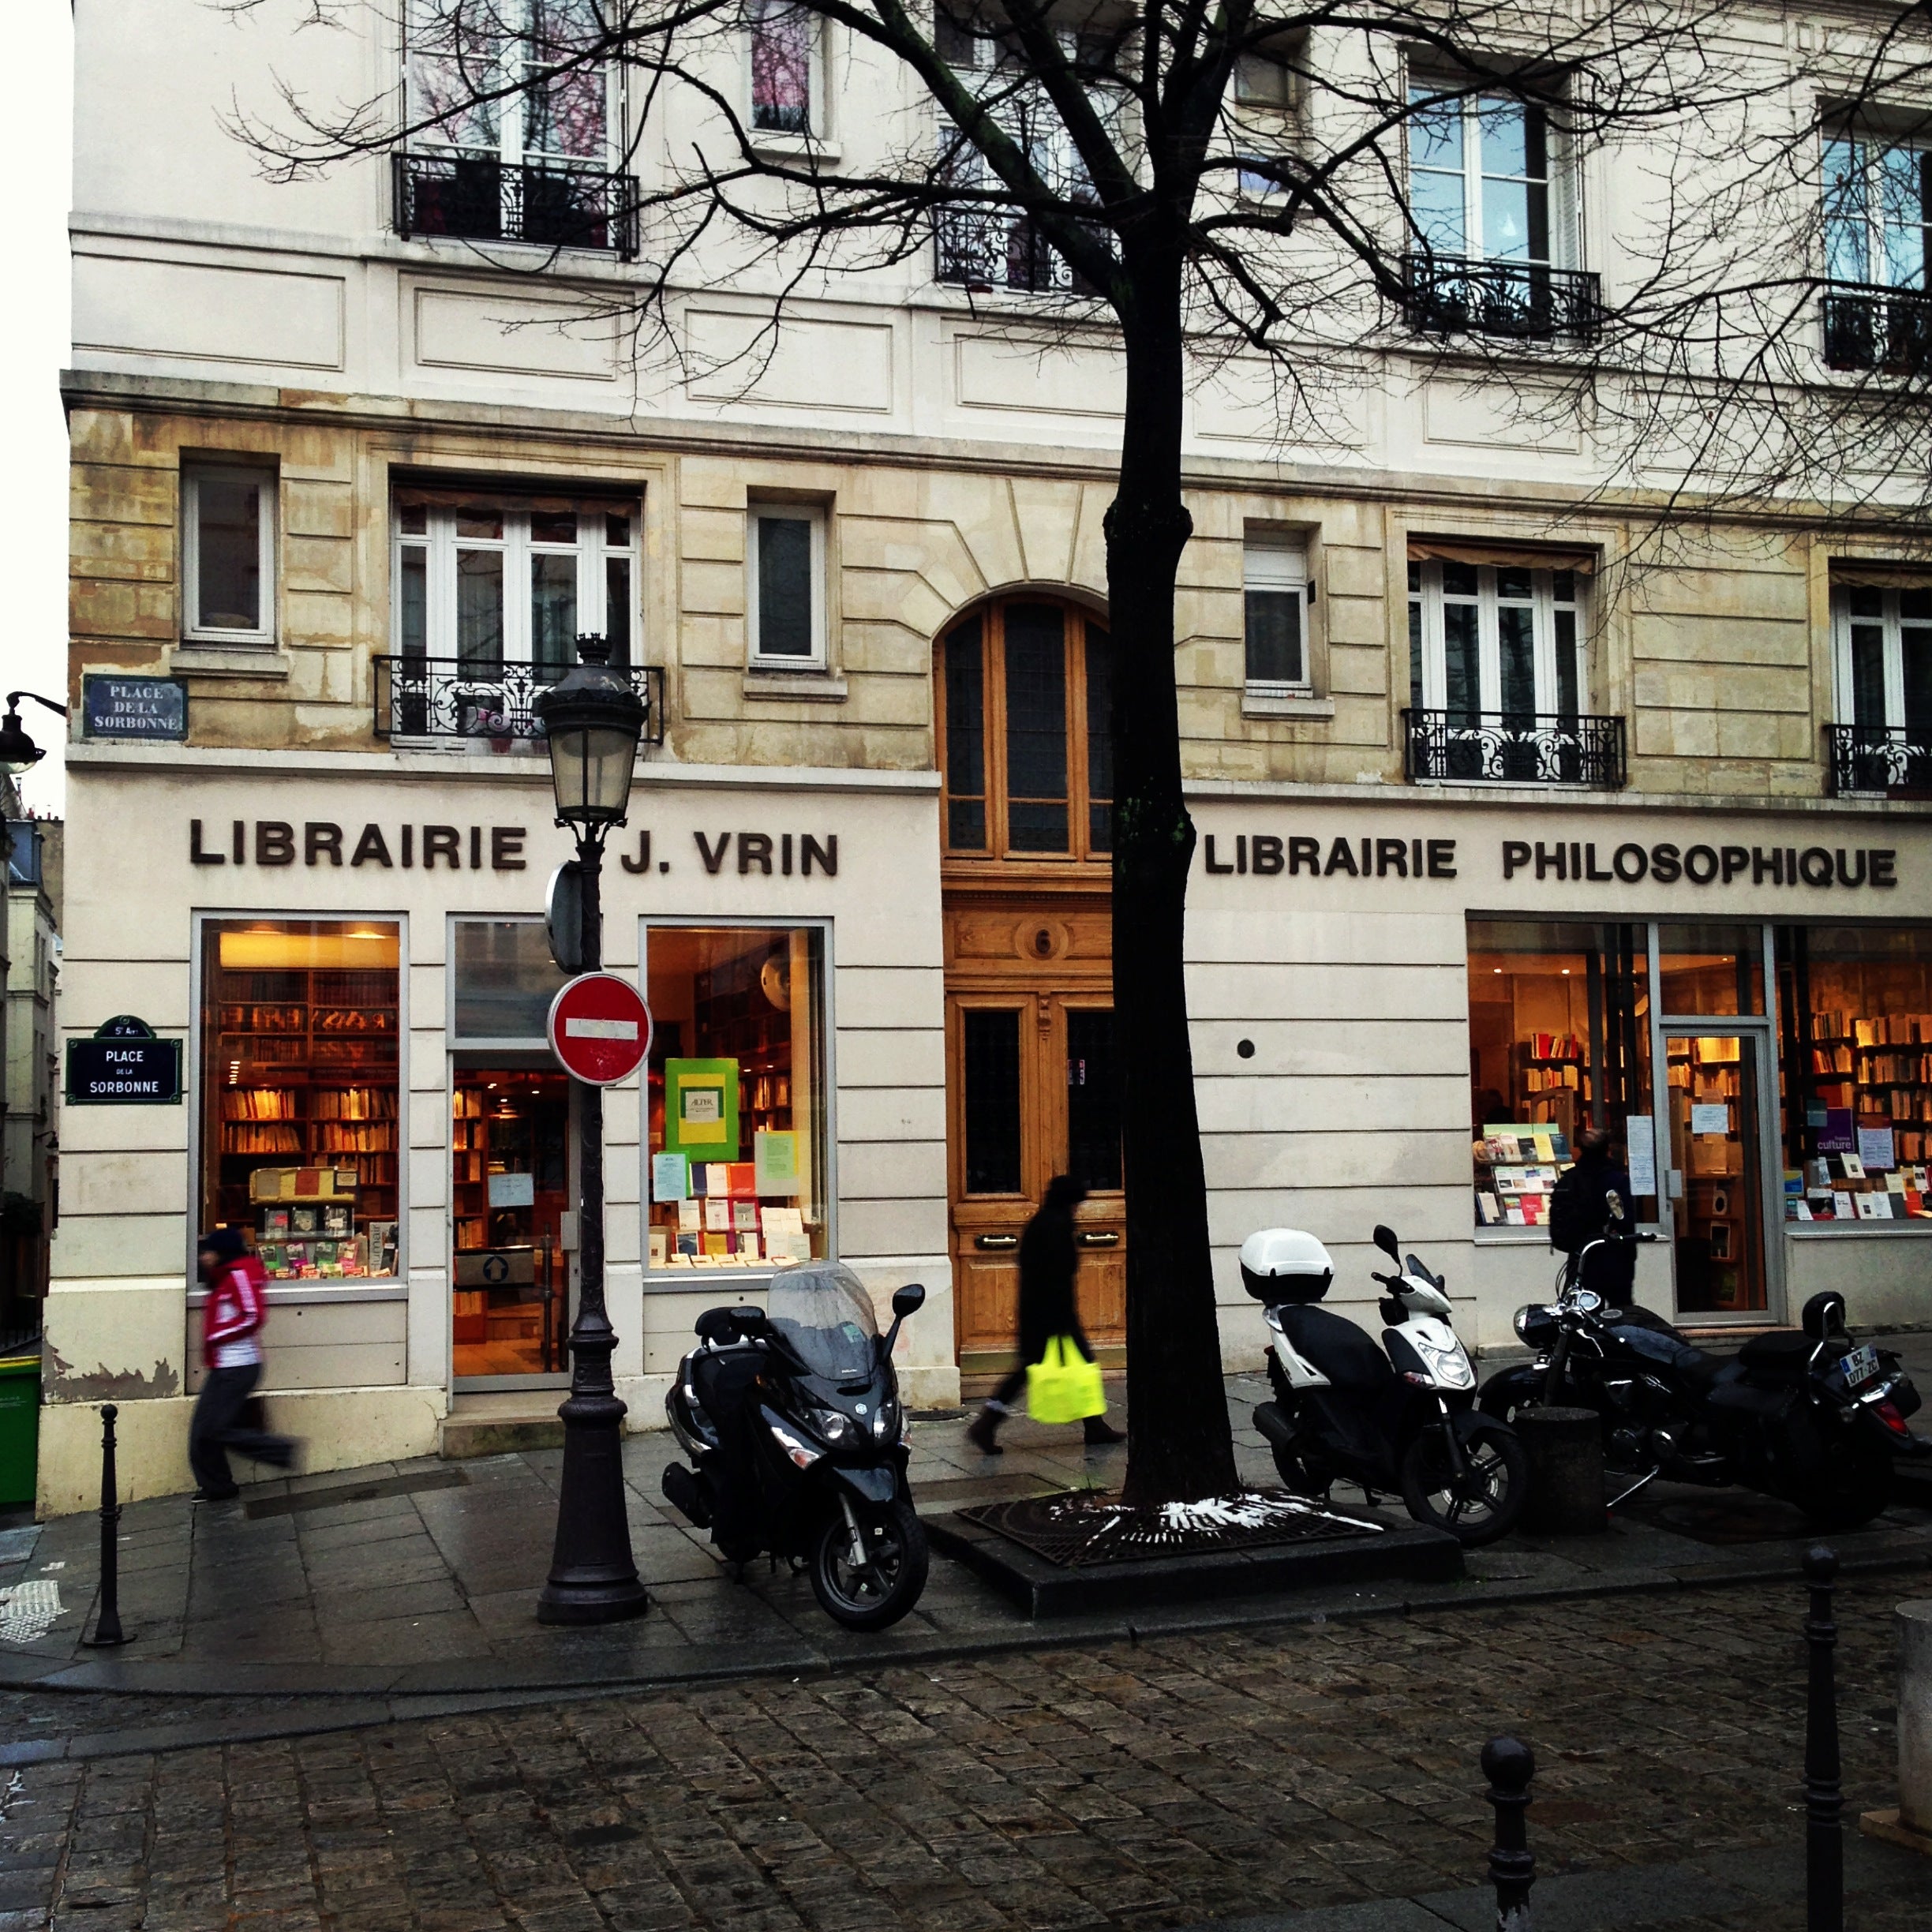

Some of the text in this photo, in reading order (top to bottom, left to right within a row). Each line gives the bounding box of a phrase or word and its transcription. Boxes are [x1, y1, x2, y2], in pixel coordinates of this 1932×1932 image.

[110, 686, 163, 699] PLACE
[114, 702, 158, 714] DE LA
[94, 716, 178, 730] SORBONNE
[190, 819, 838, 877] LIBRAIRIE J. VRIN
[1205, 834, 1898, 888] LIBRAIRIE PHILOSOPHIQUE
[106, 1050, 144, 1062] PLACE
[90, 1080, 159, 1093] SORBONNE
[1817, 1140, 1852, 1150] culture
[1852, 1351, 1864, 1366] BZ
